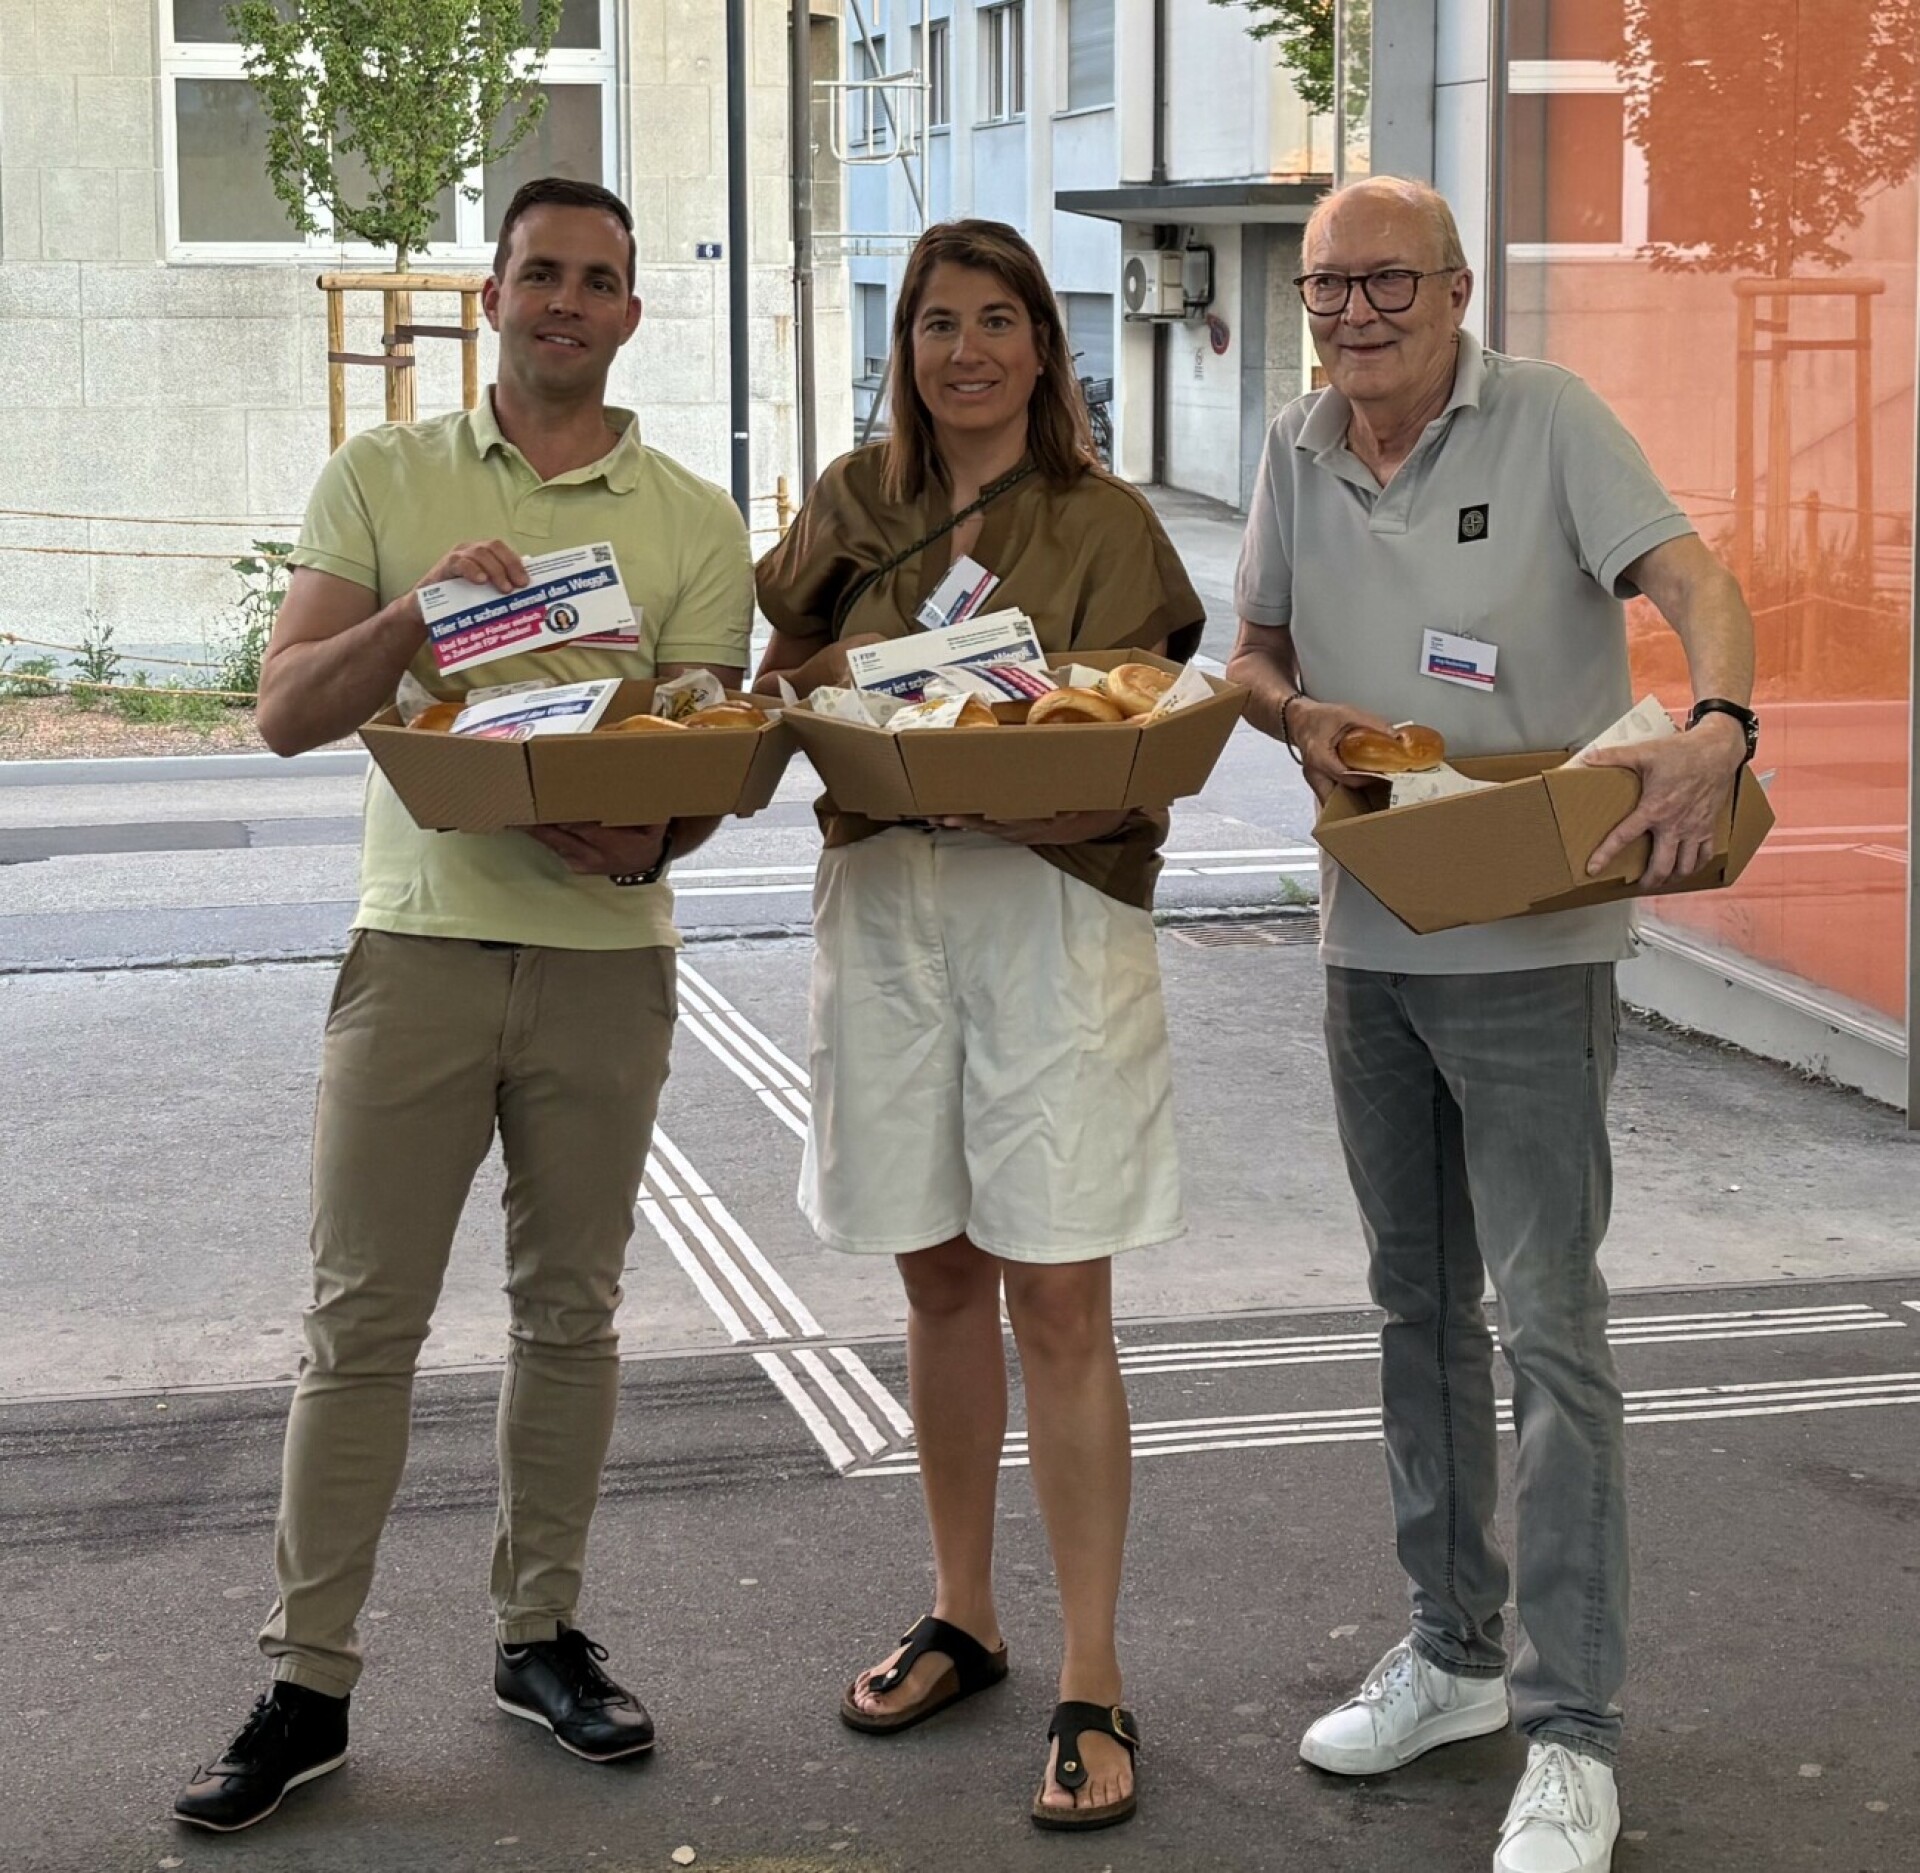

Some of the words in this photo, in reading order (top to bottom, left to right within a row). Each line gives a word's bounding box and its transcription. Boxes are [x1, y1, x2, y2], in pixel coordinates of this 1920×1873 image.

[705, 244, 714, 258] 6
[432, 623, 456, 638] Hier
[457, 615, 473, 629] ist
[473, 605, 509, 624] schon
[509, 588, 548, 612] einmal
[547, 584, 569, 599] das
[568, 570, 613, 592] Weggli.
[483, 634, 500, 648] FDP
